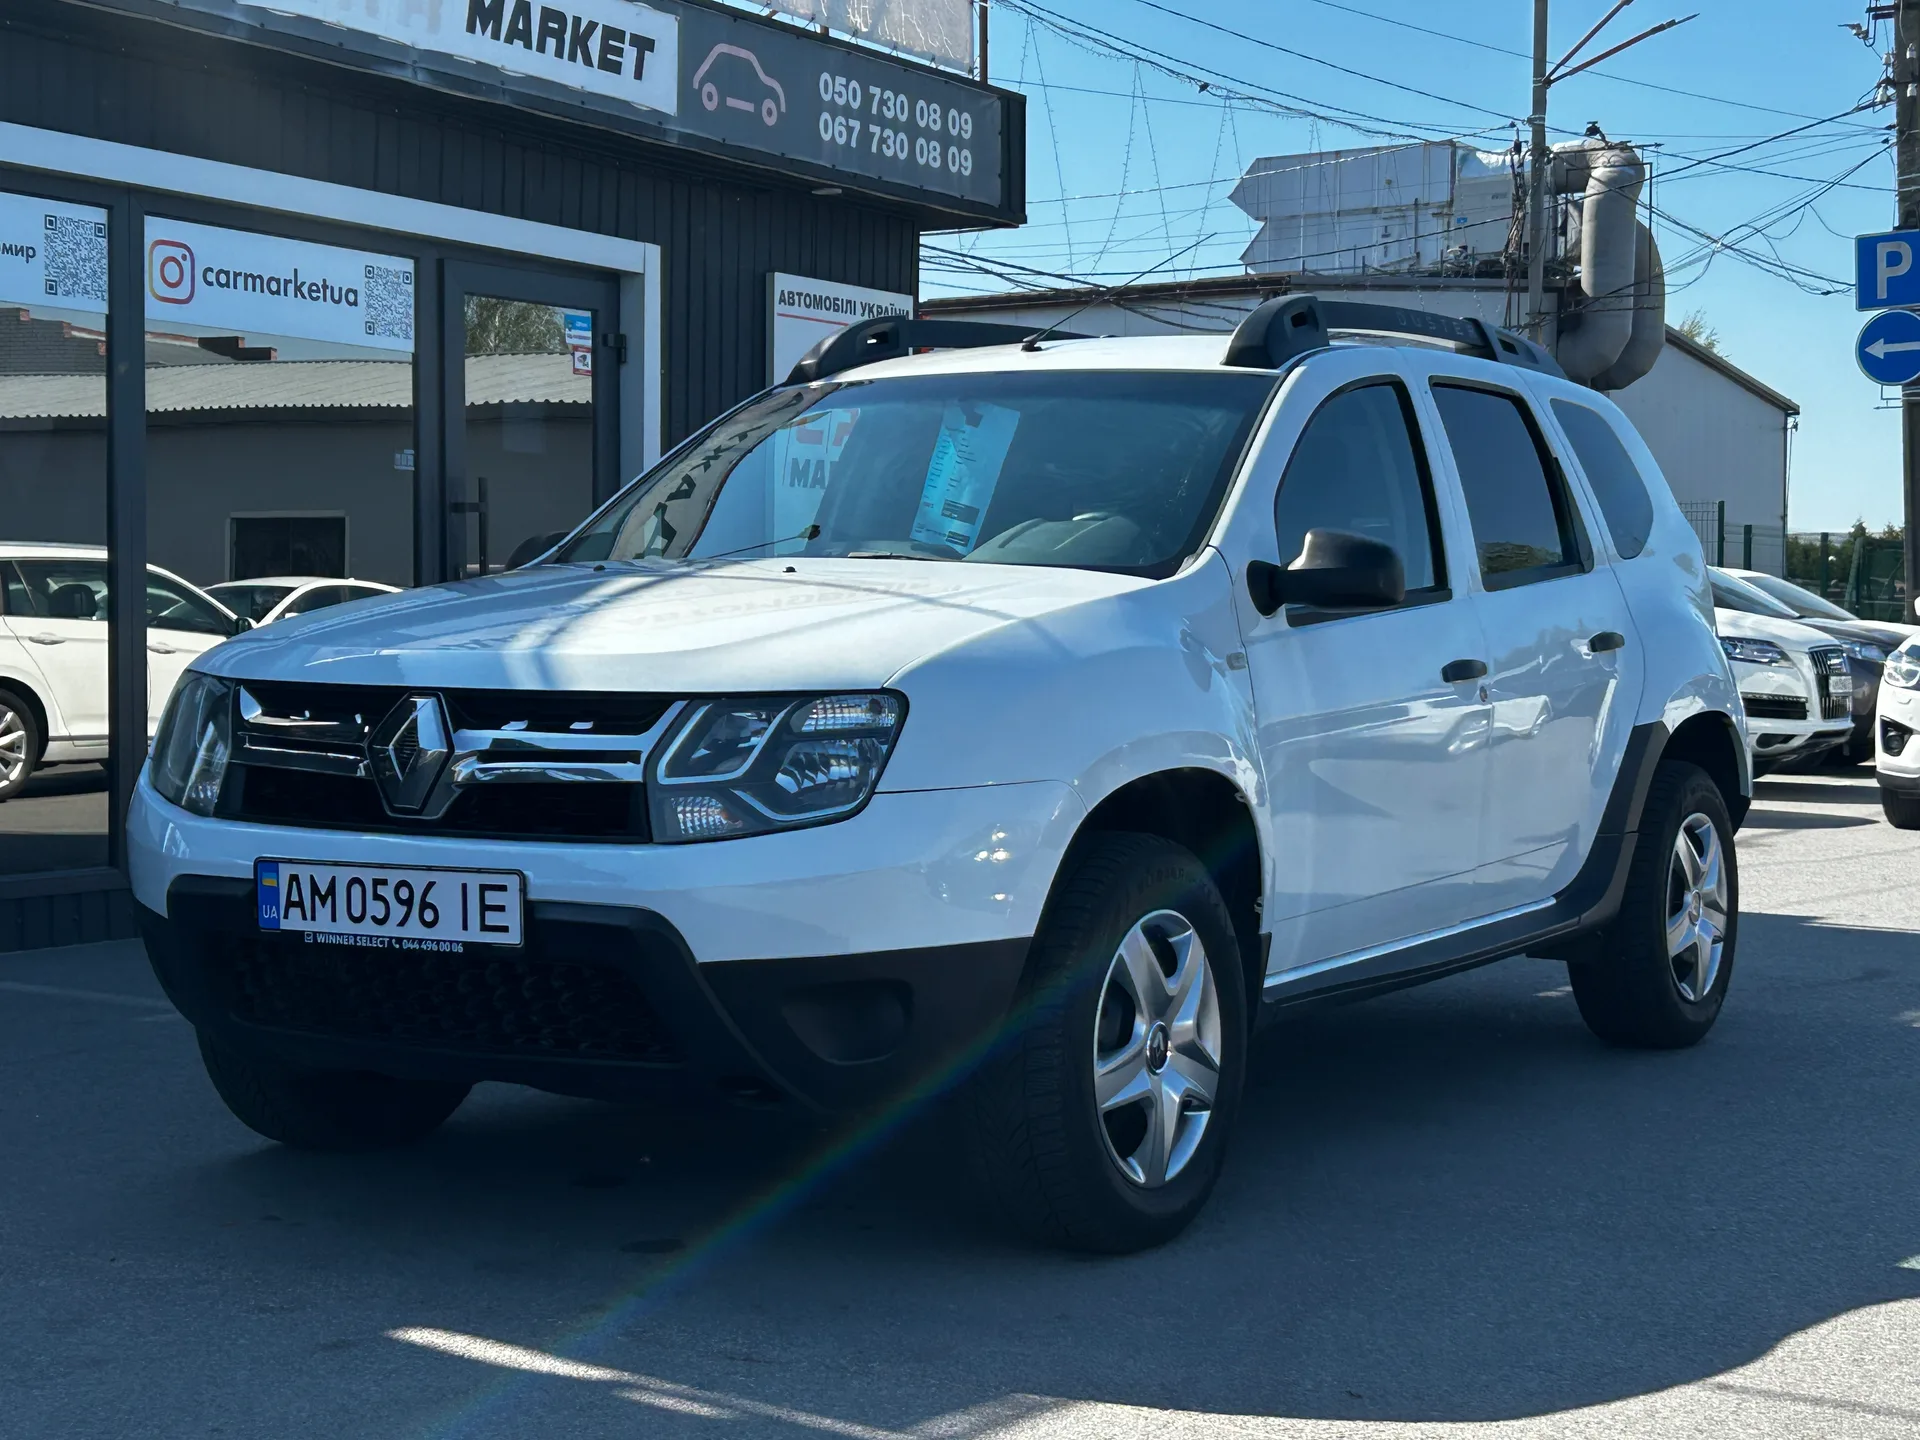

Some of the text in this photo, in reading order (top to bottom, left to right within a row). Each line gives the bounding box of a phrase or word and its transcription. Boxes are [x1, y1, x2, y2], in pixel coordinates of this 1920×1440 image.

[465, 0, 656, 80] MARKET
[819, 72, 972, 140] 050 730 08 09
[819, 112, 972, 176] 067 730 08 09
[0, 243, 37, 264] мир
[1876, 241, 1912, 299] P
[202, 266, 359, 307] carmarketua
[778, 289, 857, 316] АВТОМОБІЛІ
[262, 905, 278, 919] UA
[316, 933, 390, 948] WINNER SELECT
[402, 939, 420, 949] 044
[420, 940, 438, 951] 496
[439, 941, 451, 951] 00
